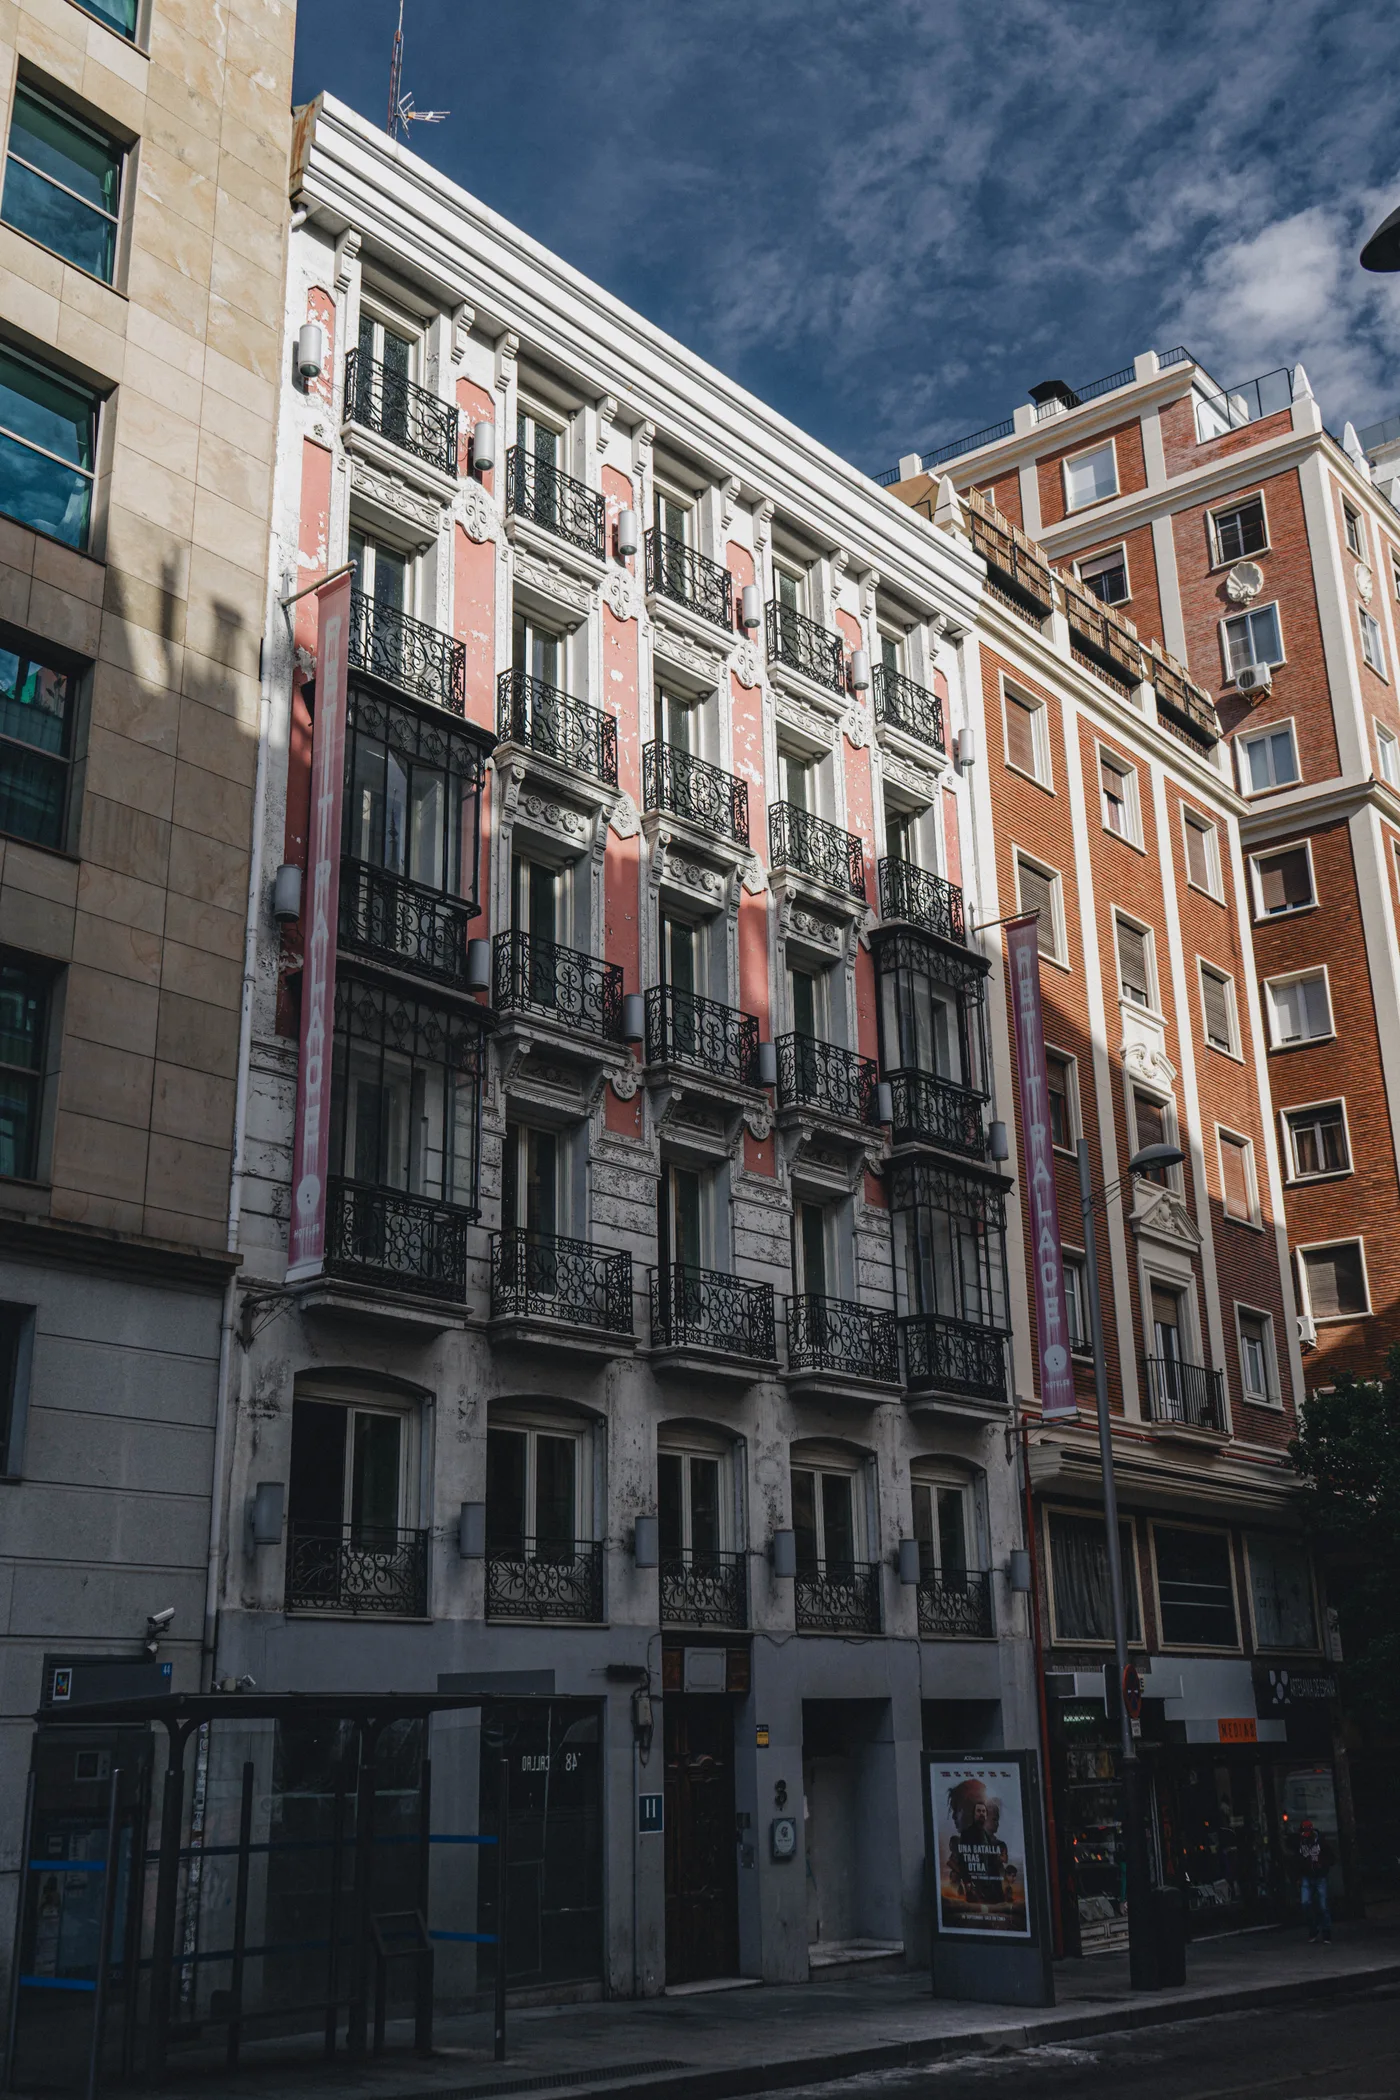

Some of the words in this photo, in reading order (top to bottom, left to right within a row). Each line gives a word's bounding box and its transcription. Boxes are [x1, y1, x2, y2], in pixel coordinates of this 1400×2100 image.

[317, 615, 342, 838] PETIT
[303, 859, 332, 1144] PALACE
[1015, 945, 1042, 1110] PETIT
[1030, 1123, 1061, 1323] PALACE
[1045, 1379, 1070, 1389] HOTELES
[1220, 1722, 1255, 1738] MEDIAS
[645, 1798, 656, 1818] H
[958, 1844, 972, 1853] UNA
[973, 1844, 1001, 1854] BATALLA
[964, 1854, 979, 1862] TRAS
[968, 1862, 986, 1872] OTRA
